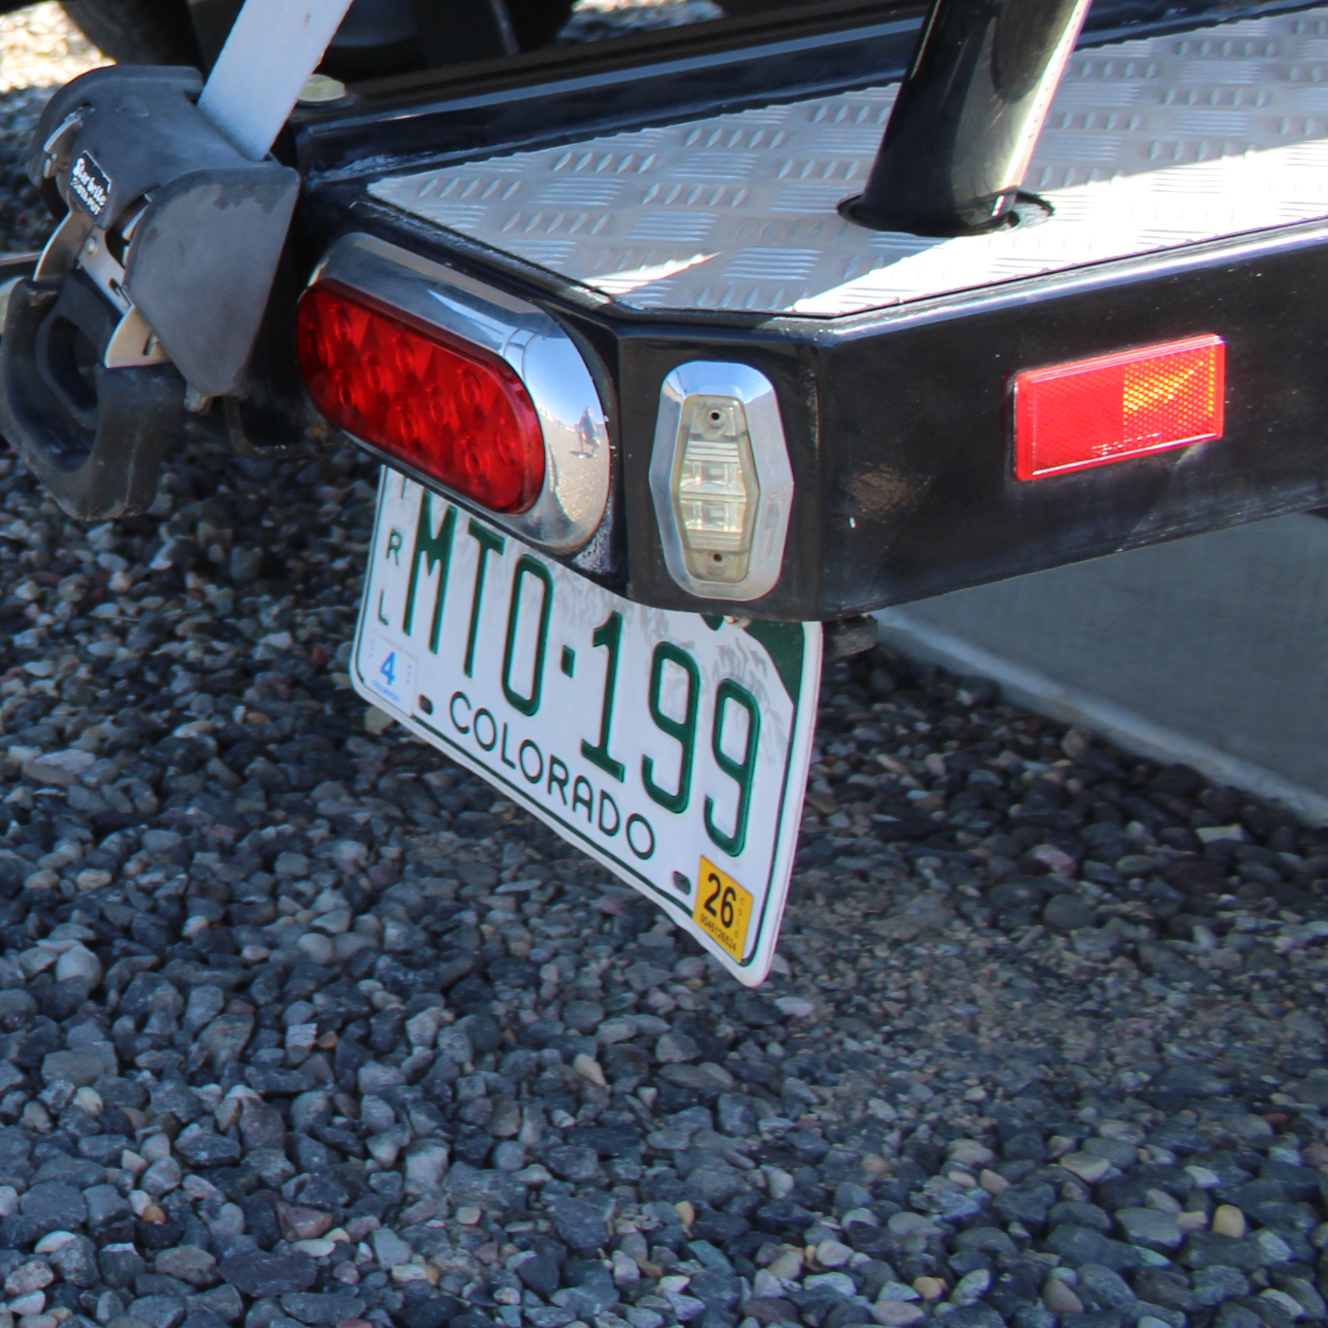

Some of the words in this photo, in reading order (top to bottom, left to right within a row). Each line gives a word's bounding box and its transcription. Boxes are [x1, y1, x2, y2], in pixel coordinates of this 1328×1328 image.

[380, 651, 397, 686] 4
[448, 690, 657, 862] COLORADO
[703, 872, 737, 929] 26
